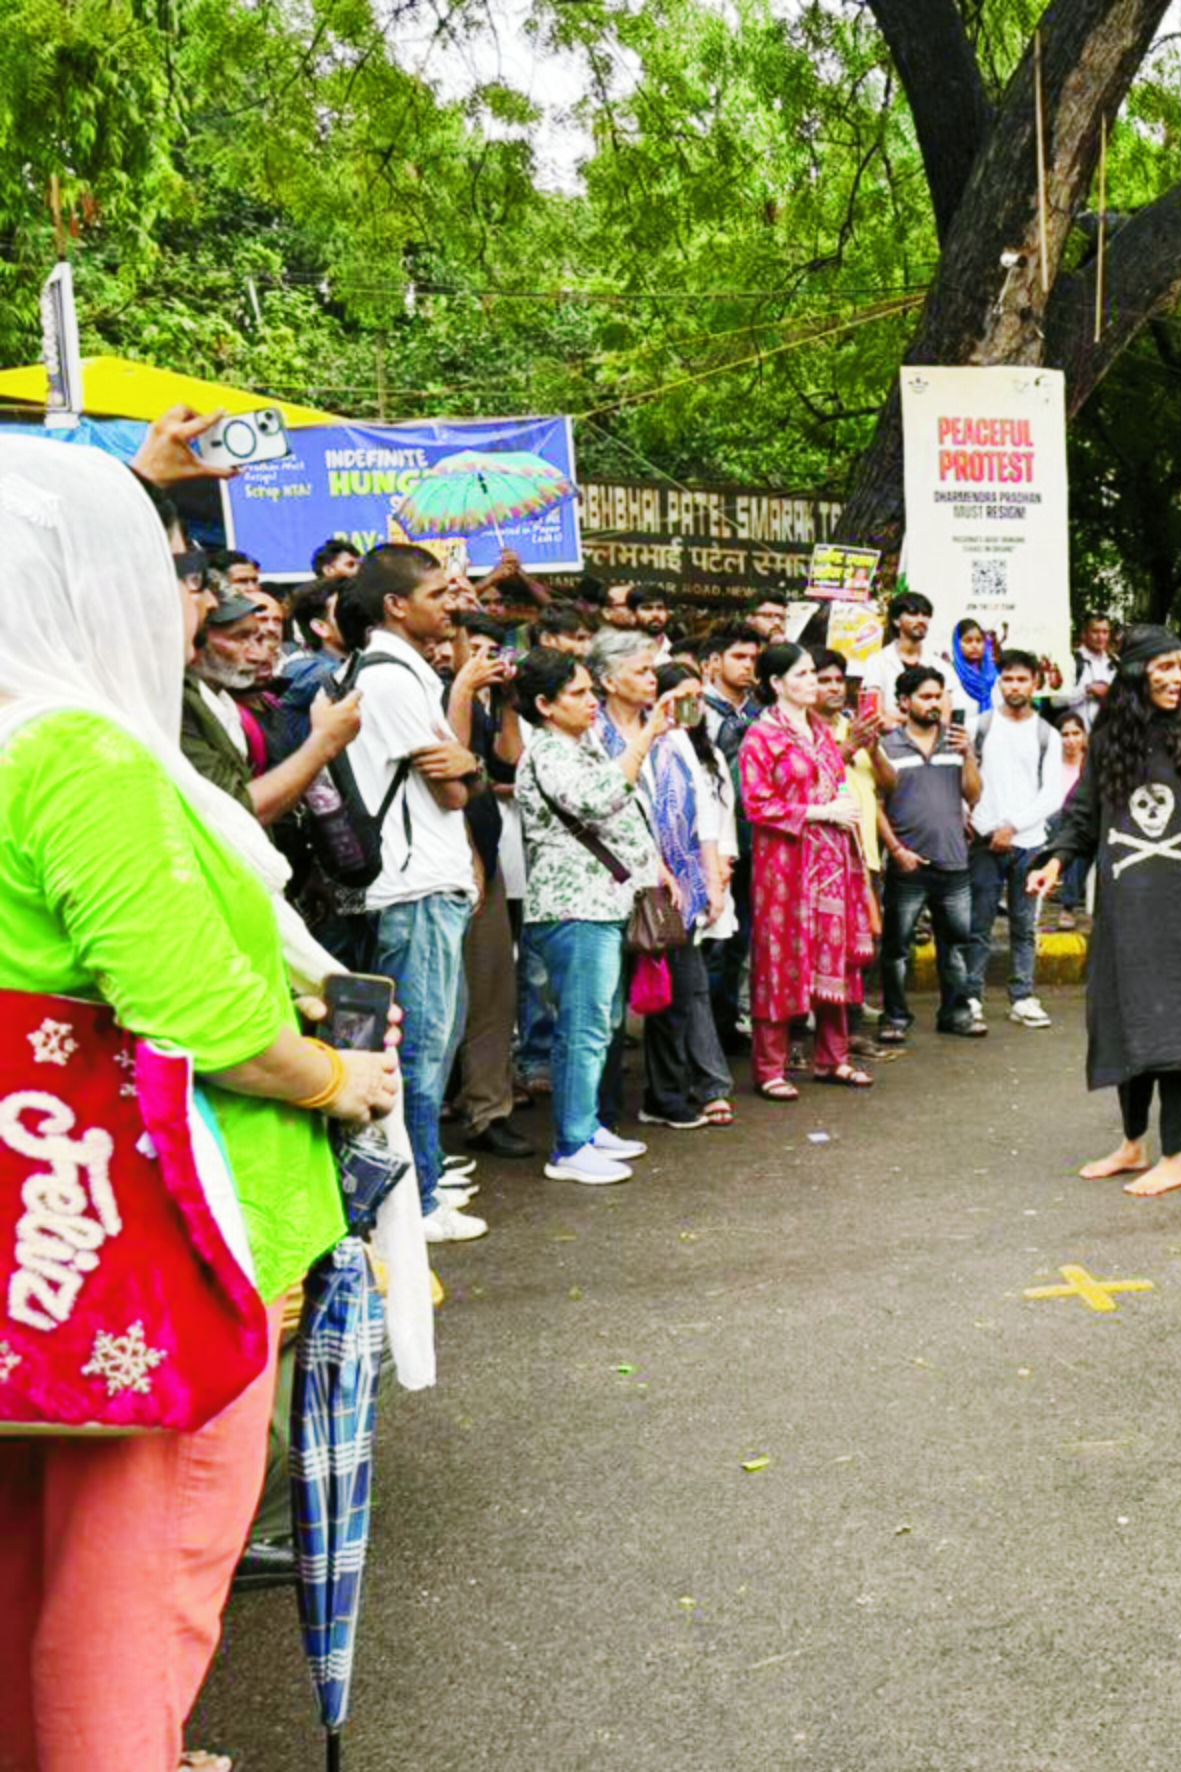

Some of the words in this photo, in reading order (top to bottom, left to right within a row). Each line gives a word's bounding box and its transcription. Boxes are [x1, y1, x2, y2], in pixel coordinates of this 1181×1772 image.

[937, 416, 1034, 448] PEACEFUL
[325, 448, 429, 470] INDEFINITE
[939, 450, 1035, 483] PROTEST
[328, 469, 437, 498] HUNG
[667, 489, 732, 537] PATEL
[736, 495, 816, 542] SMARAK
[953, 505, 983, 520] MUST
[689, 540, 748, 574] पटेल
[752, 549, 812, 578] स्मार
[0, 1090, 123, 1333] Feliz
